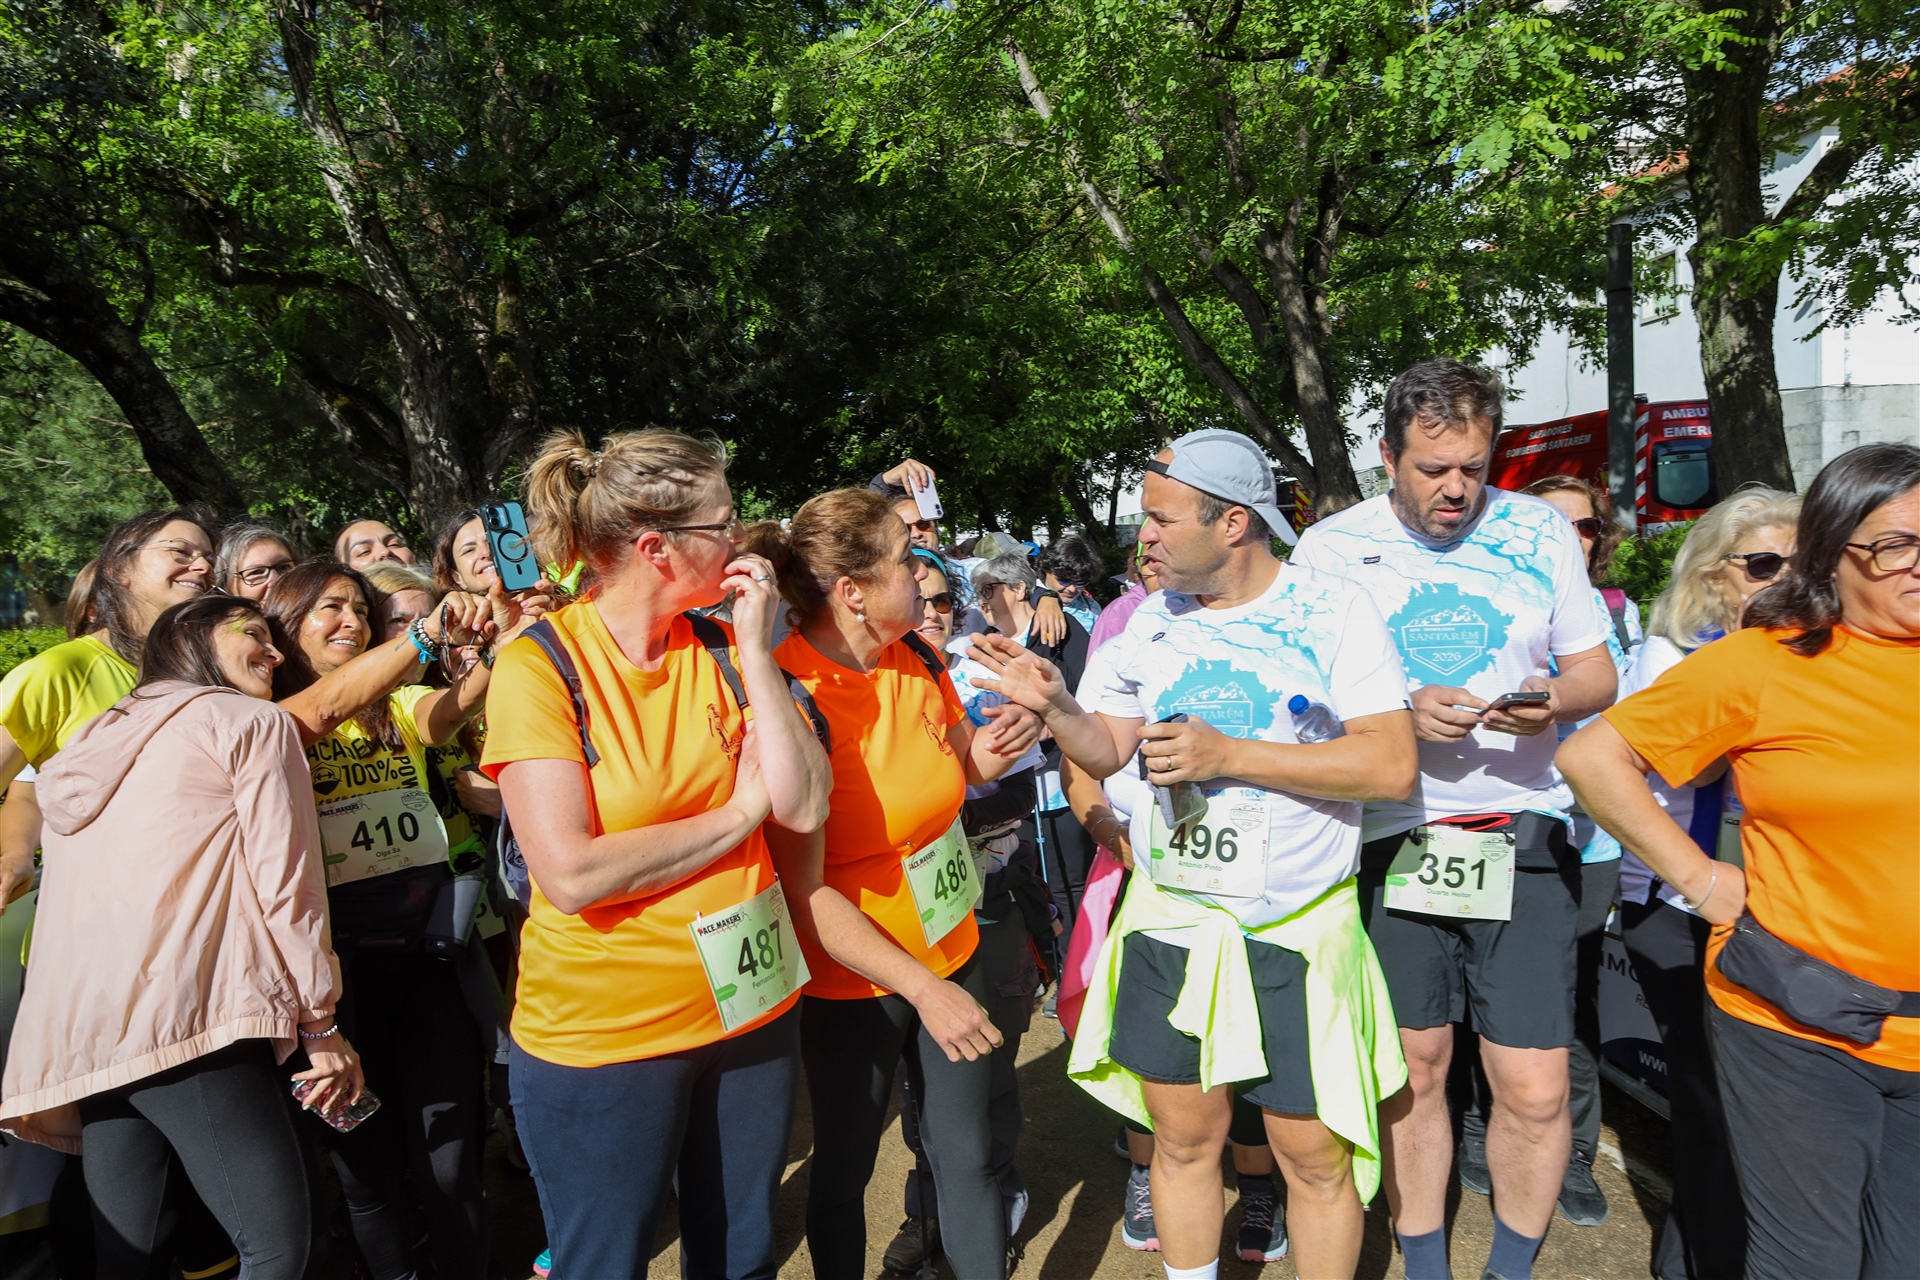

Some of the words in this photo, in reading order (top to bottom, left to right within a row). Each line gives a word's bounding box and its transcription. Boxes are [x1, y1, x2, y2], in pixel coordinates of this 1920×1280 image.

[1662, 408, 1710, 420] AMBU
[1528, 424, 1574, 440] SAPADORES
[1506, 442, 1548, 458] BOMBEIROS
[1548, 433, 1592, 449] SANTARÉM
[1409, 630, 1480, 642] SANTARÉM
[1432, 651, 1462, 662] 2026
[1186, 707, 1245, 720] NTARÉM
[341, 758, 398, 788] 100%
[1205, 788, 1226, 797] 0KM
[1239, 788, 1267, 797] 10KM
[351, 812, 419, 851] 410
[1169, 822, 1238, 863] 496
[375, 849, 391, 858] Olga
[934, 849, 968, 901] 486
[1204, 863, 1222, 872] Pinto
[1417, 852, 1486, 891] 351
[1426, 887, 1449, 897] Duarte
[737, 919, 783, 977] 487
[752, 972, 777, 990] Fernanda
